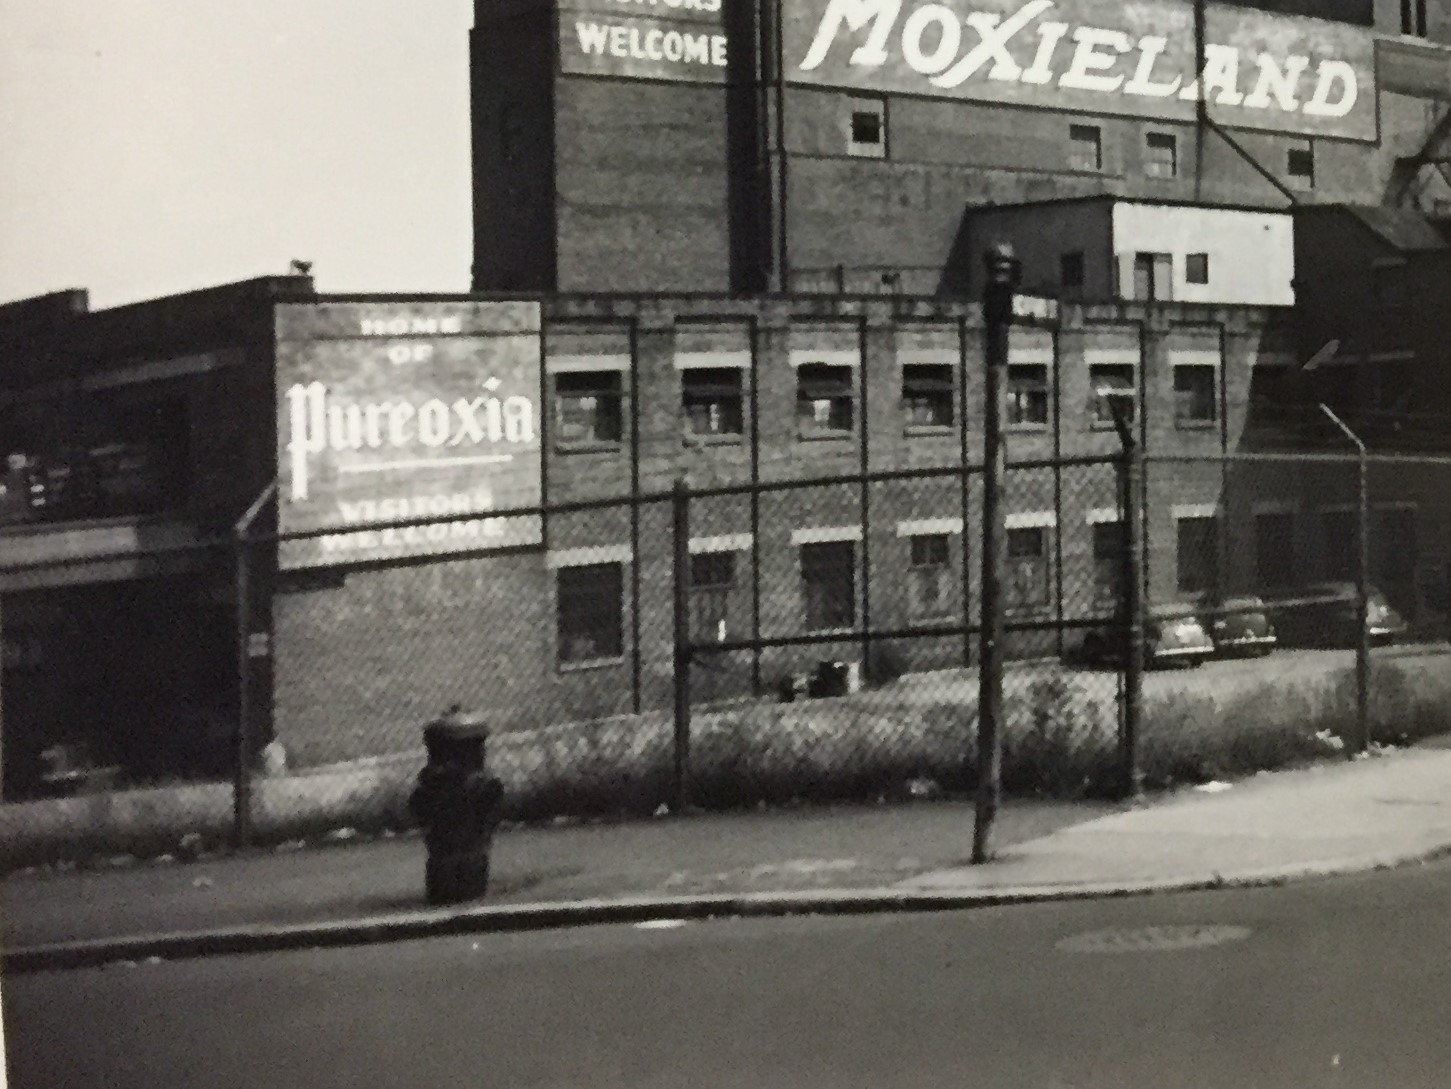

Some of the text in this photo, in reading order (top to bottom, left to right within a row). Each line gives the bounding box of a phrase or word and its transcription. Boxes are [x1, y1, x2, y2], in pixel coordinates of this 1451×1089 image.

[575, 22, 728, 67] WELCOME
[360, 314, 462, 336] HOME
[387, 344, 433, 364] OF
[285, 376, 535, 503] Pureoxia
